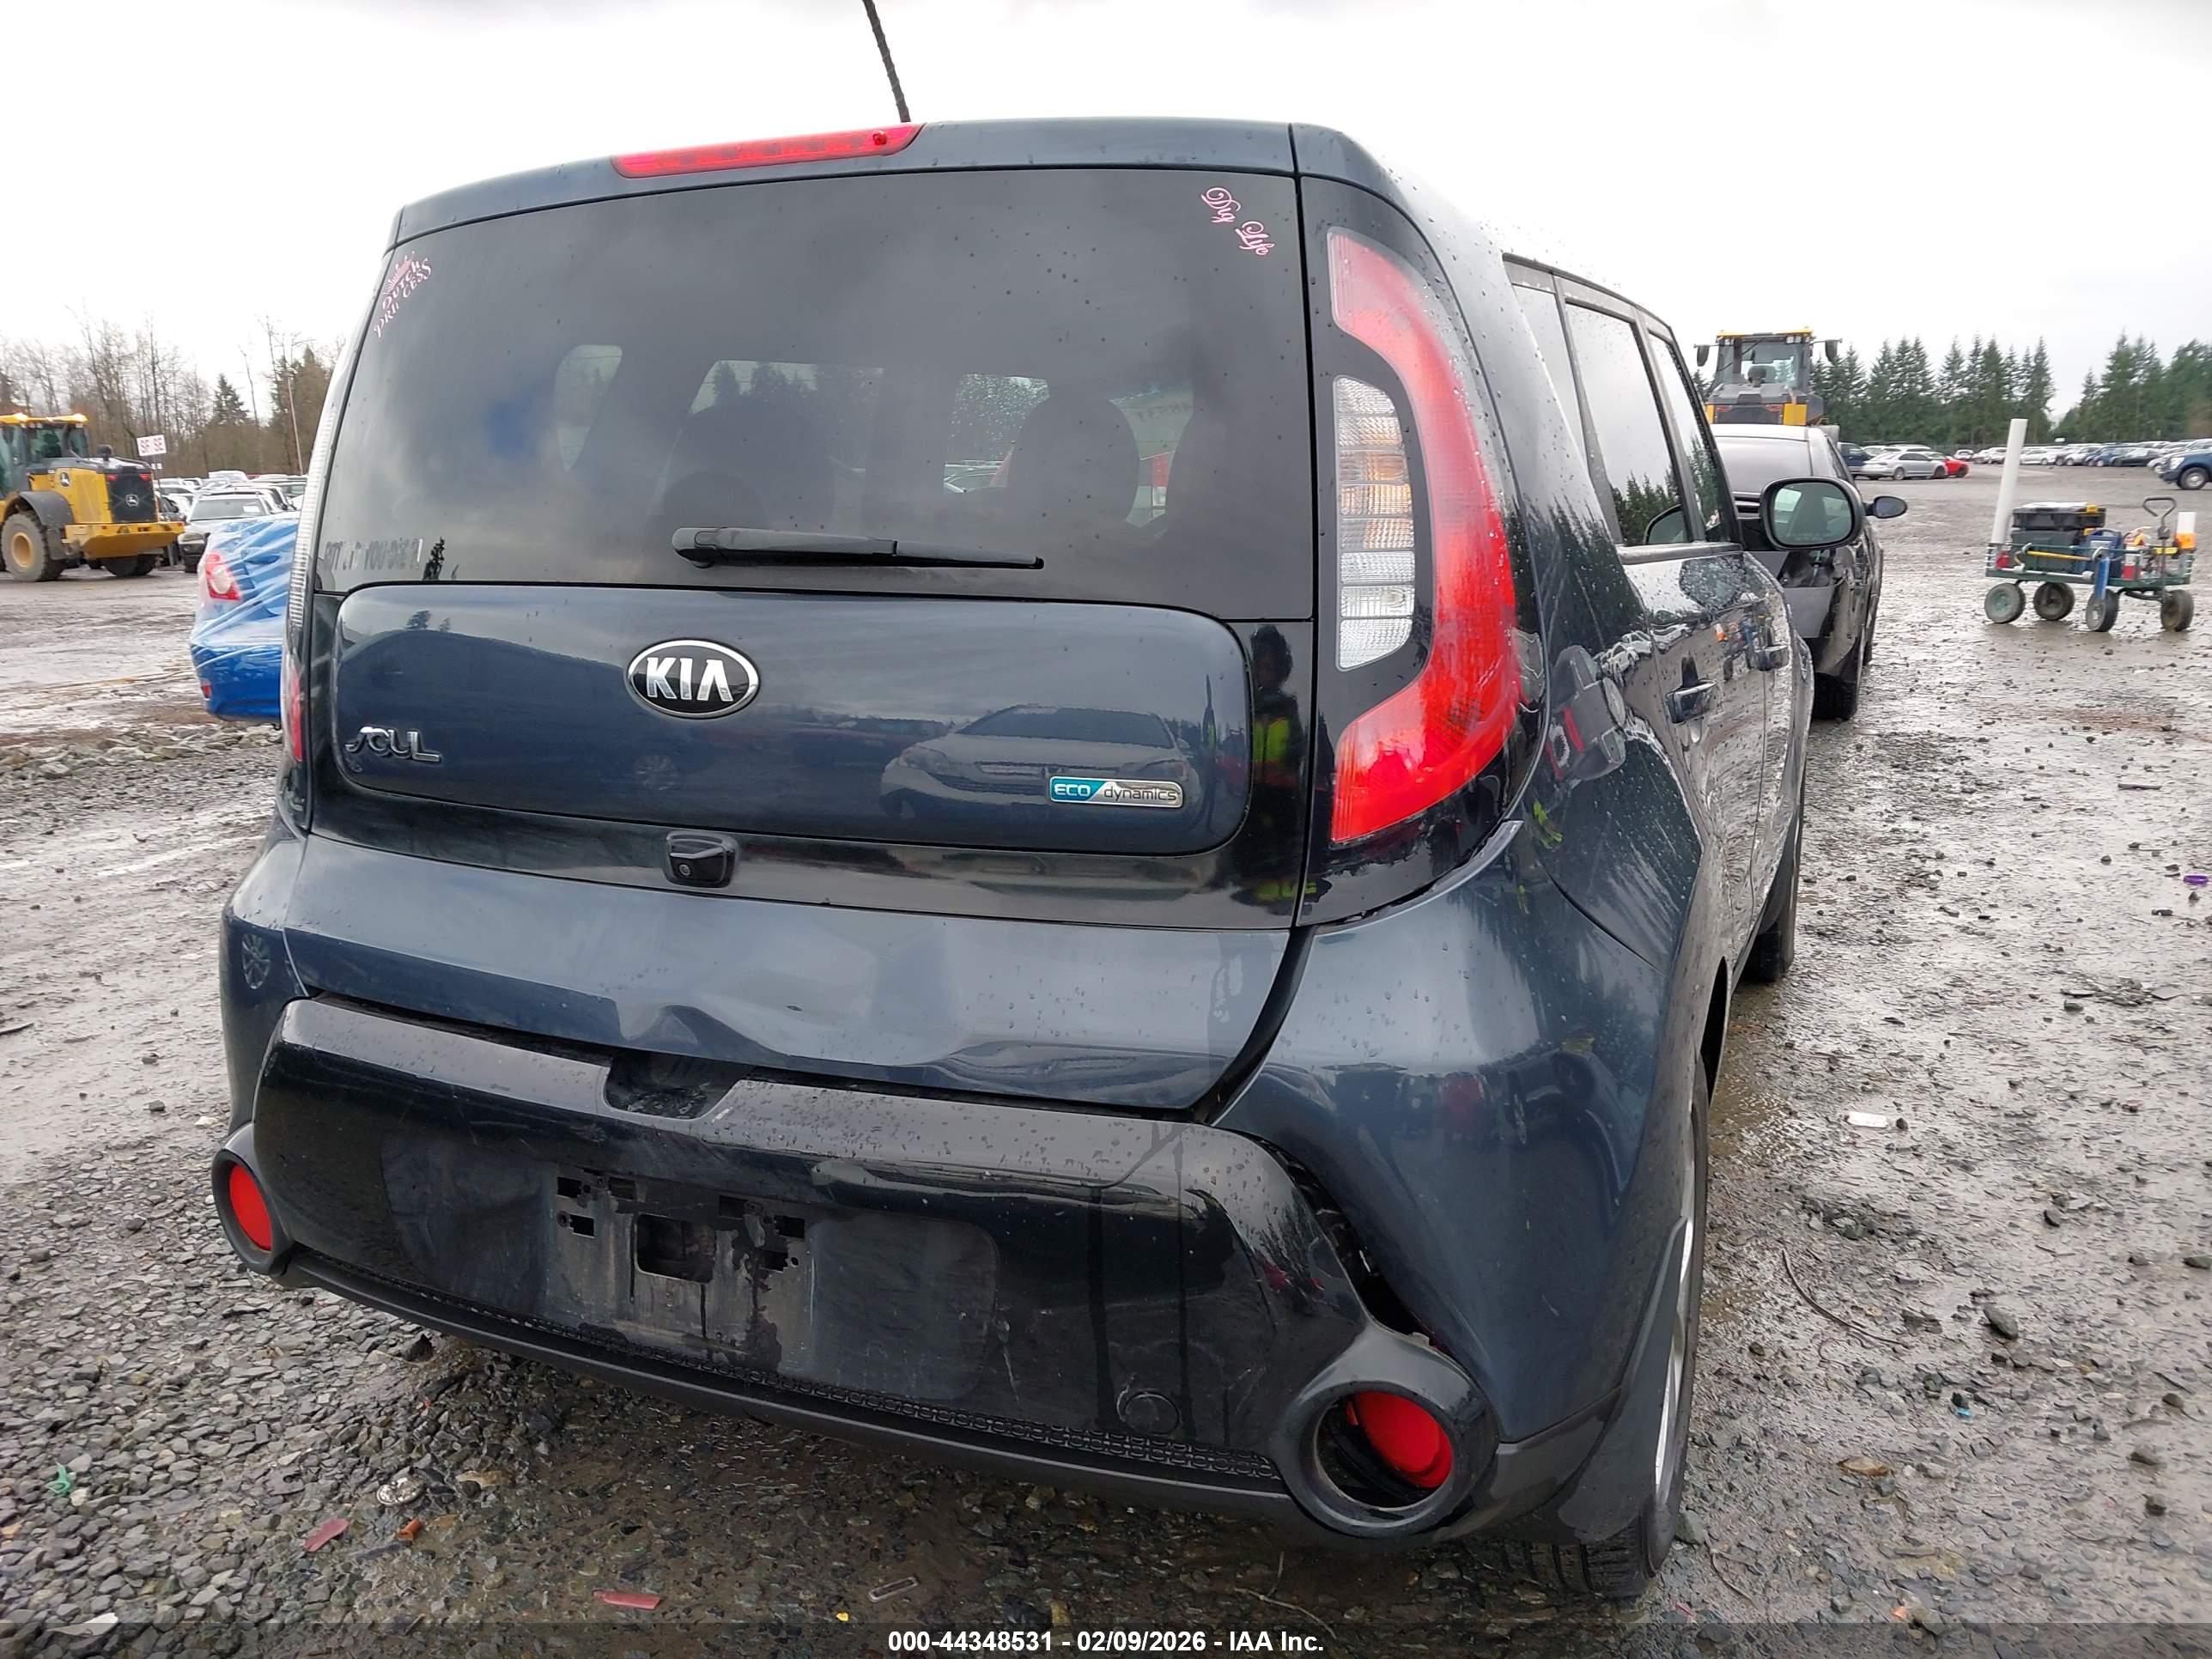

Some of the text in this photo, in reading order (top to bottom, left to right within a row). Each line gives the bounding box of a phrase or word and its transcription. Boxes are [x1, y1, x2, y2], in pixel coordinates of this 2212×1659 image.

[646, 657, 734, 702] KIA
[344, 726, 441, 763] SOUL
[1054, 783, 1178, 802] ECO dynamics
